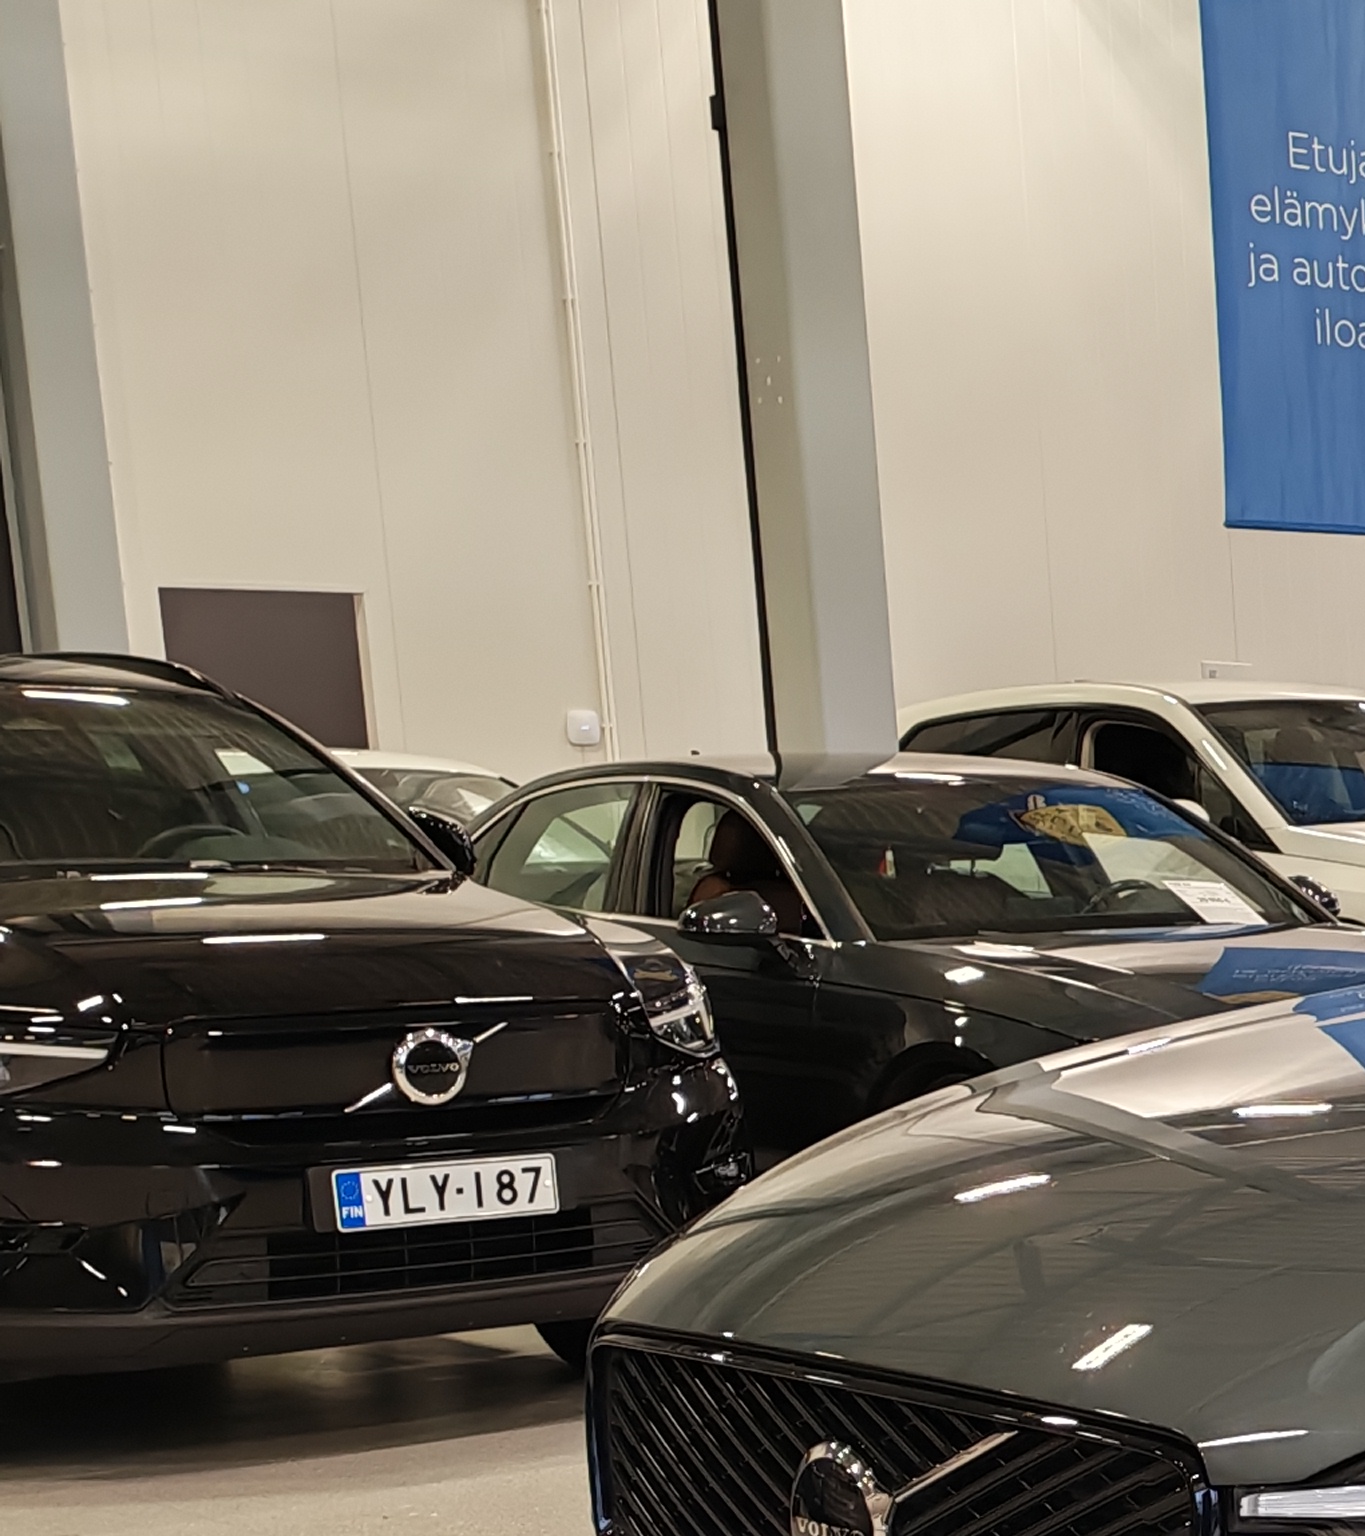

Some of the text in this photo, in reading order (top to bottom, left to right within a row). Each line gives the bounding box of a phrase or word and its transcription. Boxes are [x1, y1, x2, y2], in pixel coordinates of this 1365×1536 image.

[1248, 242, 1279, 287] ja
[407, 1062, 460, 1074] VOLVO
[372, 1166, 542, 1217] YLY-187
[342, 1204, 364, 1219] FIN
